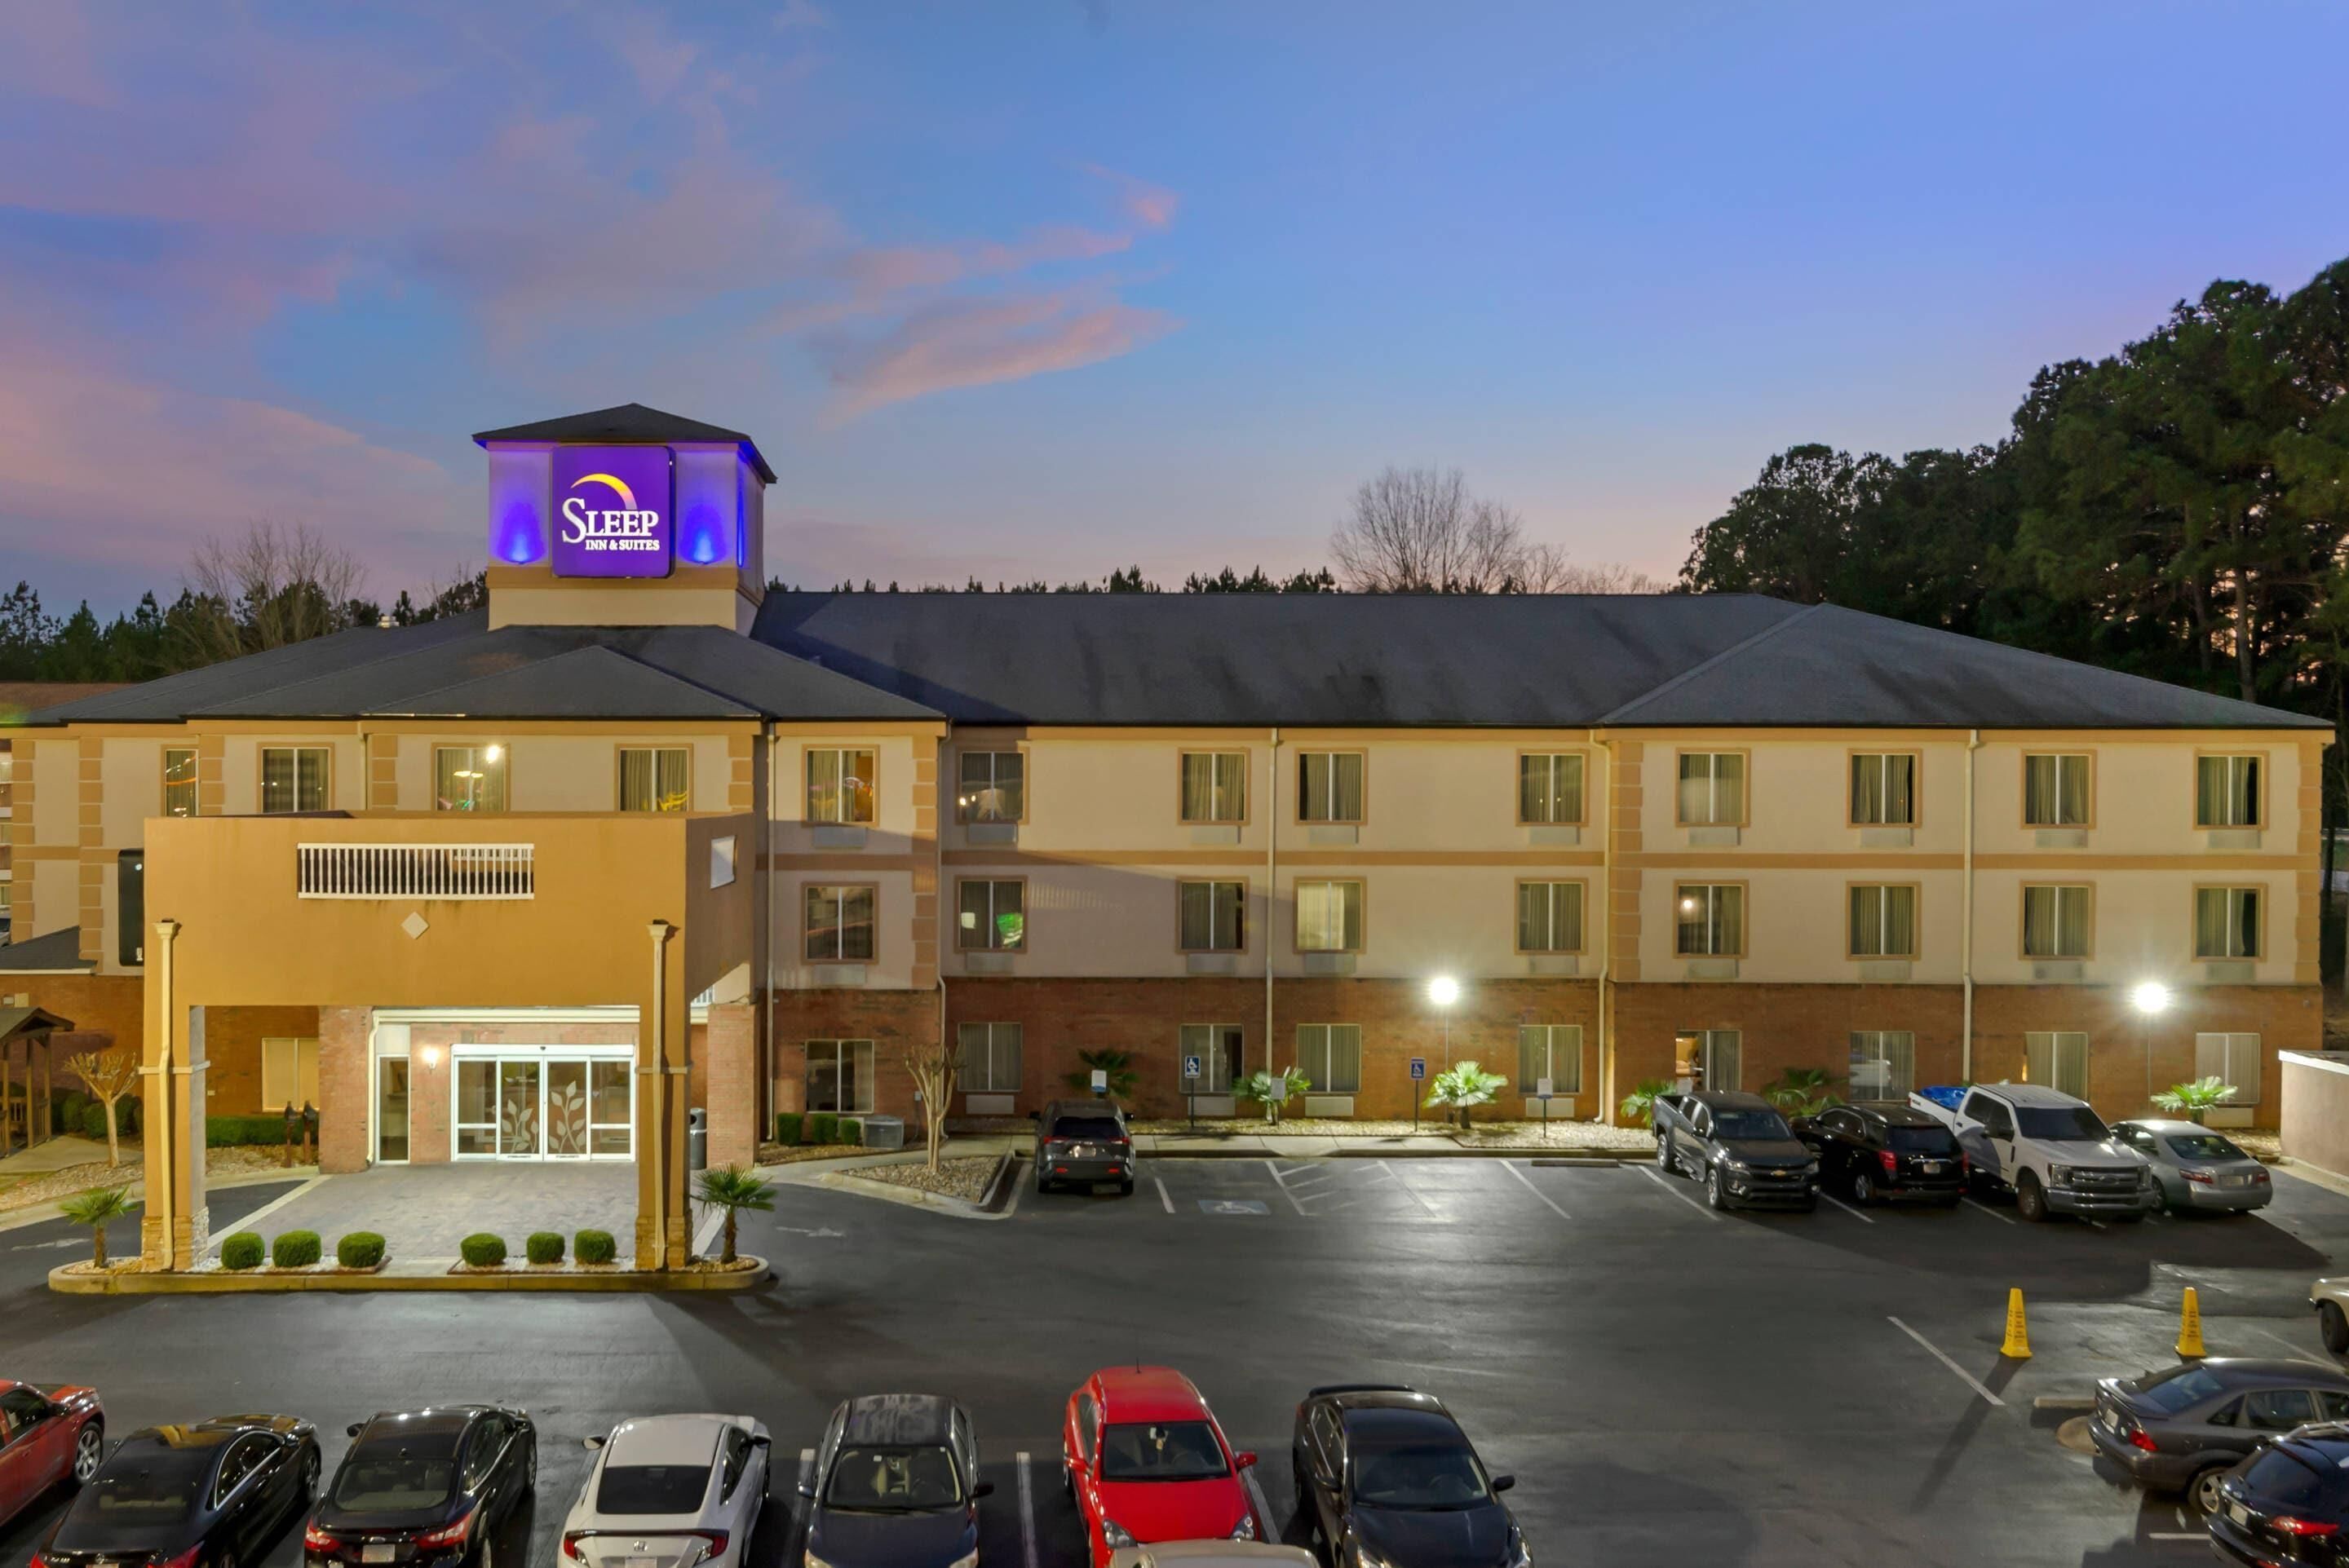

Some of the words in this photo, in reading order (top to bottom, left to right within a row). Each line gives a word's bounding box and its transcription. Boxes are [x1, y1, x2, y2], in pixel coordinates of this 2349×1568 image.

[562, 497, 659, 543] SLEEP
[585, 539, 608, 550] INN
[608, 539, 617, 550] &
[619, 539, 660, 550] SUITES
